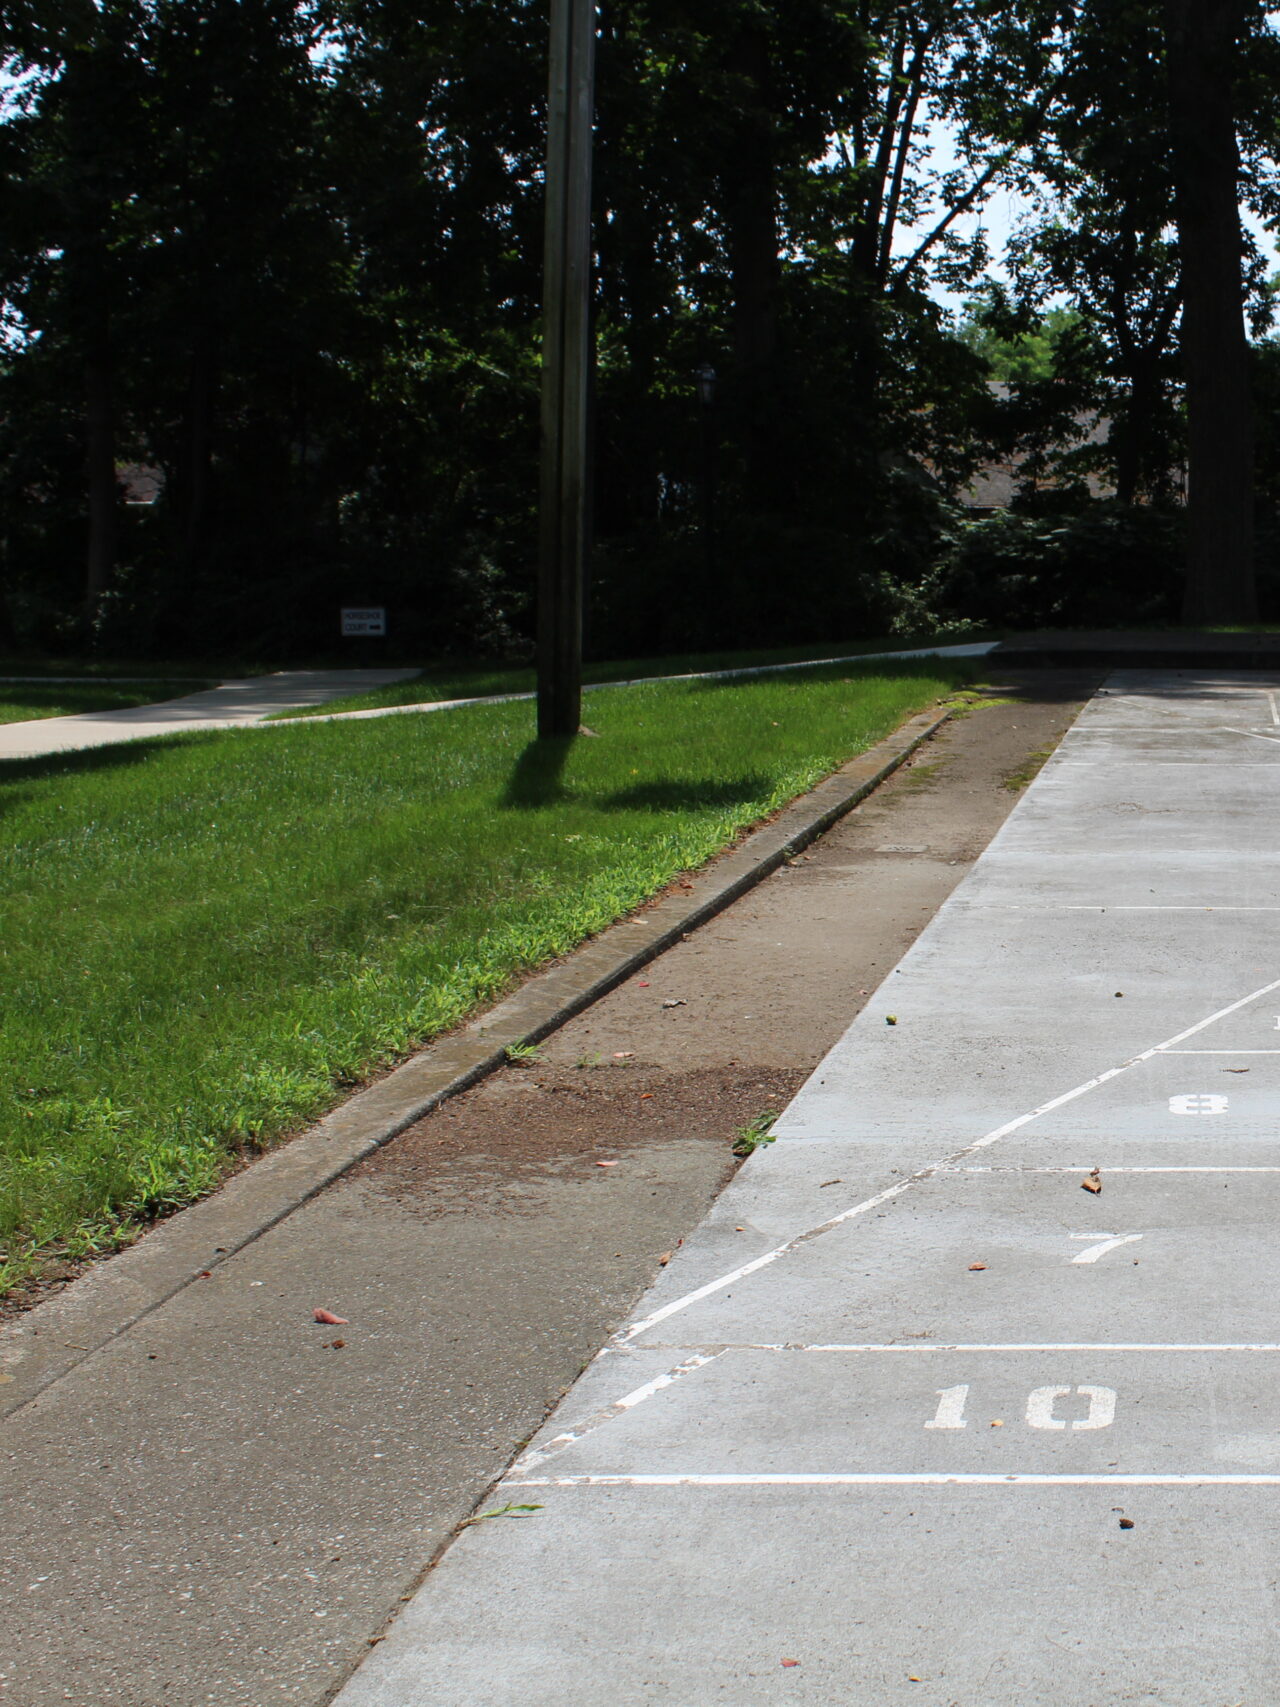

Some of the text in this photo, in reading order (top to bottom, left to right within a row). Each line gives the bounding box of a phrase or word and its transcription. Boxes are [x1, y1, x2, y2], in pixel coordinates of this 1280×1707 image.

[1168, 1094, 1229, 1115] 8
[1070, 1232, 1143, 1264] 7
[924, 1384, 1117, 1431] 10
